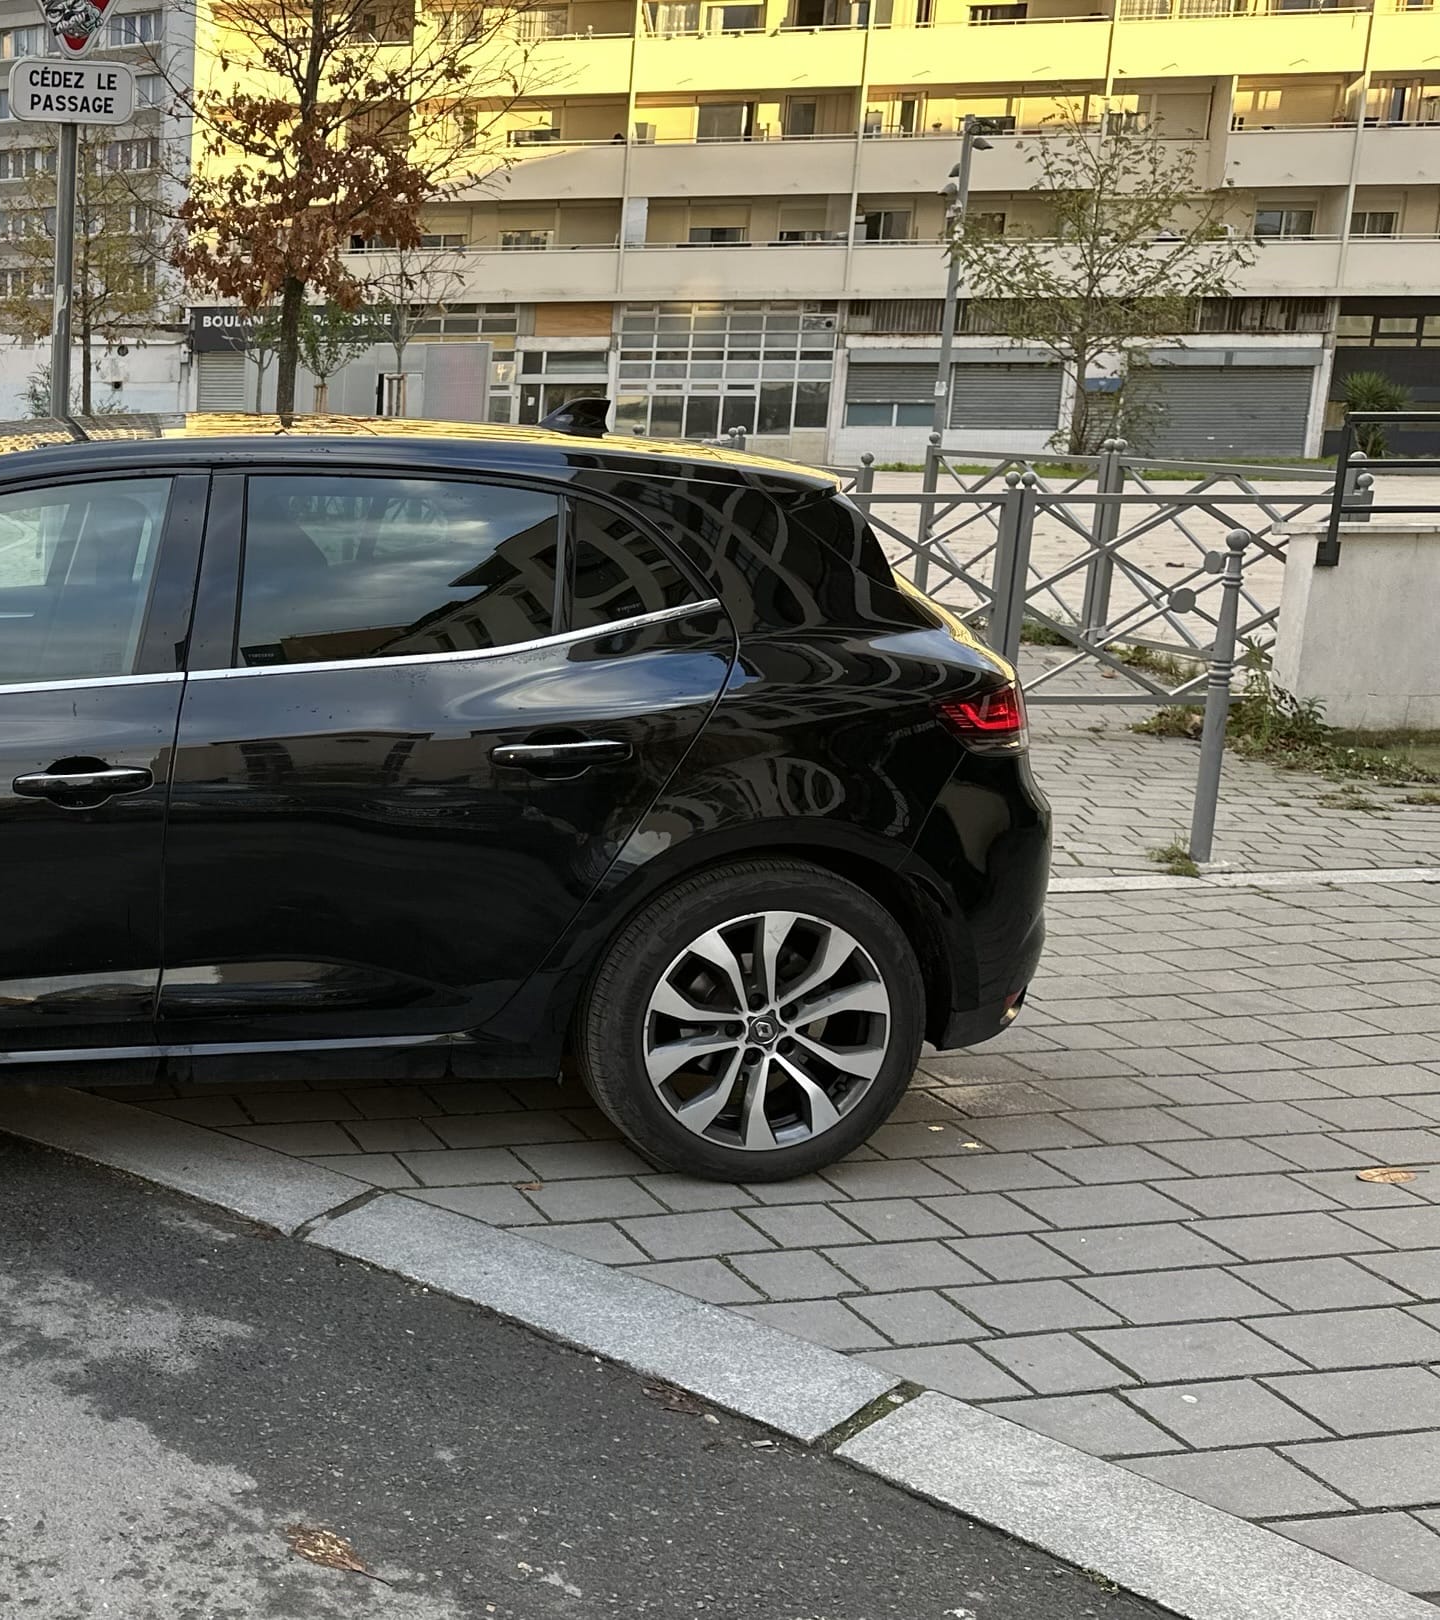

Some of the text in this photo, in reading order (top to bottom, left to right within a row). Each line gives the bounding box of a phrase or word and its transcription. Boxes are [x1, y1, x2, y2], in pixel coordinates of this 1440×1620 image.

[29, 66, 118, 91] CÉDEZ LE
[30, 93, 114, 114] PASSAGE
